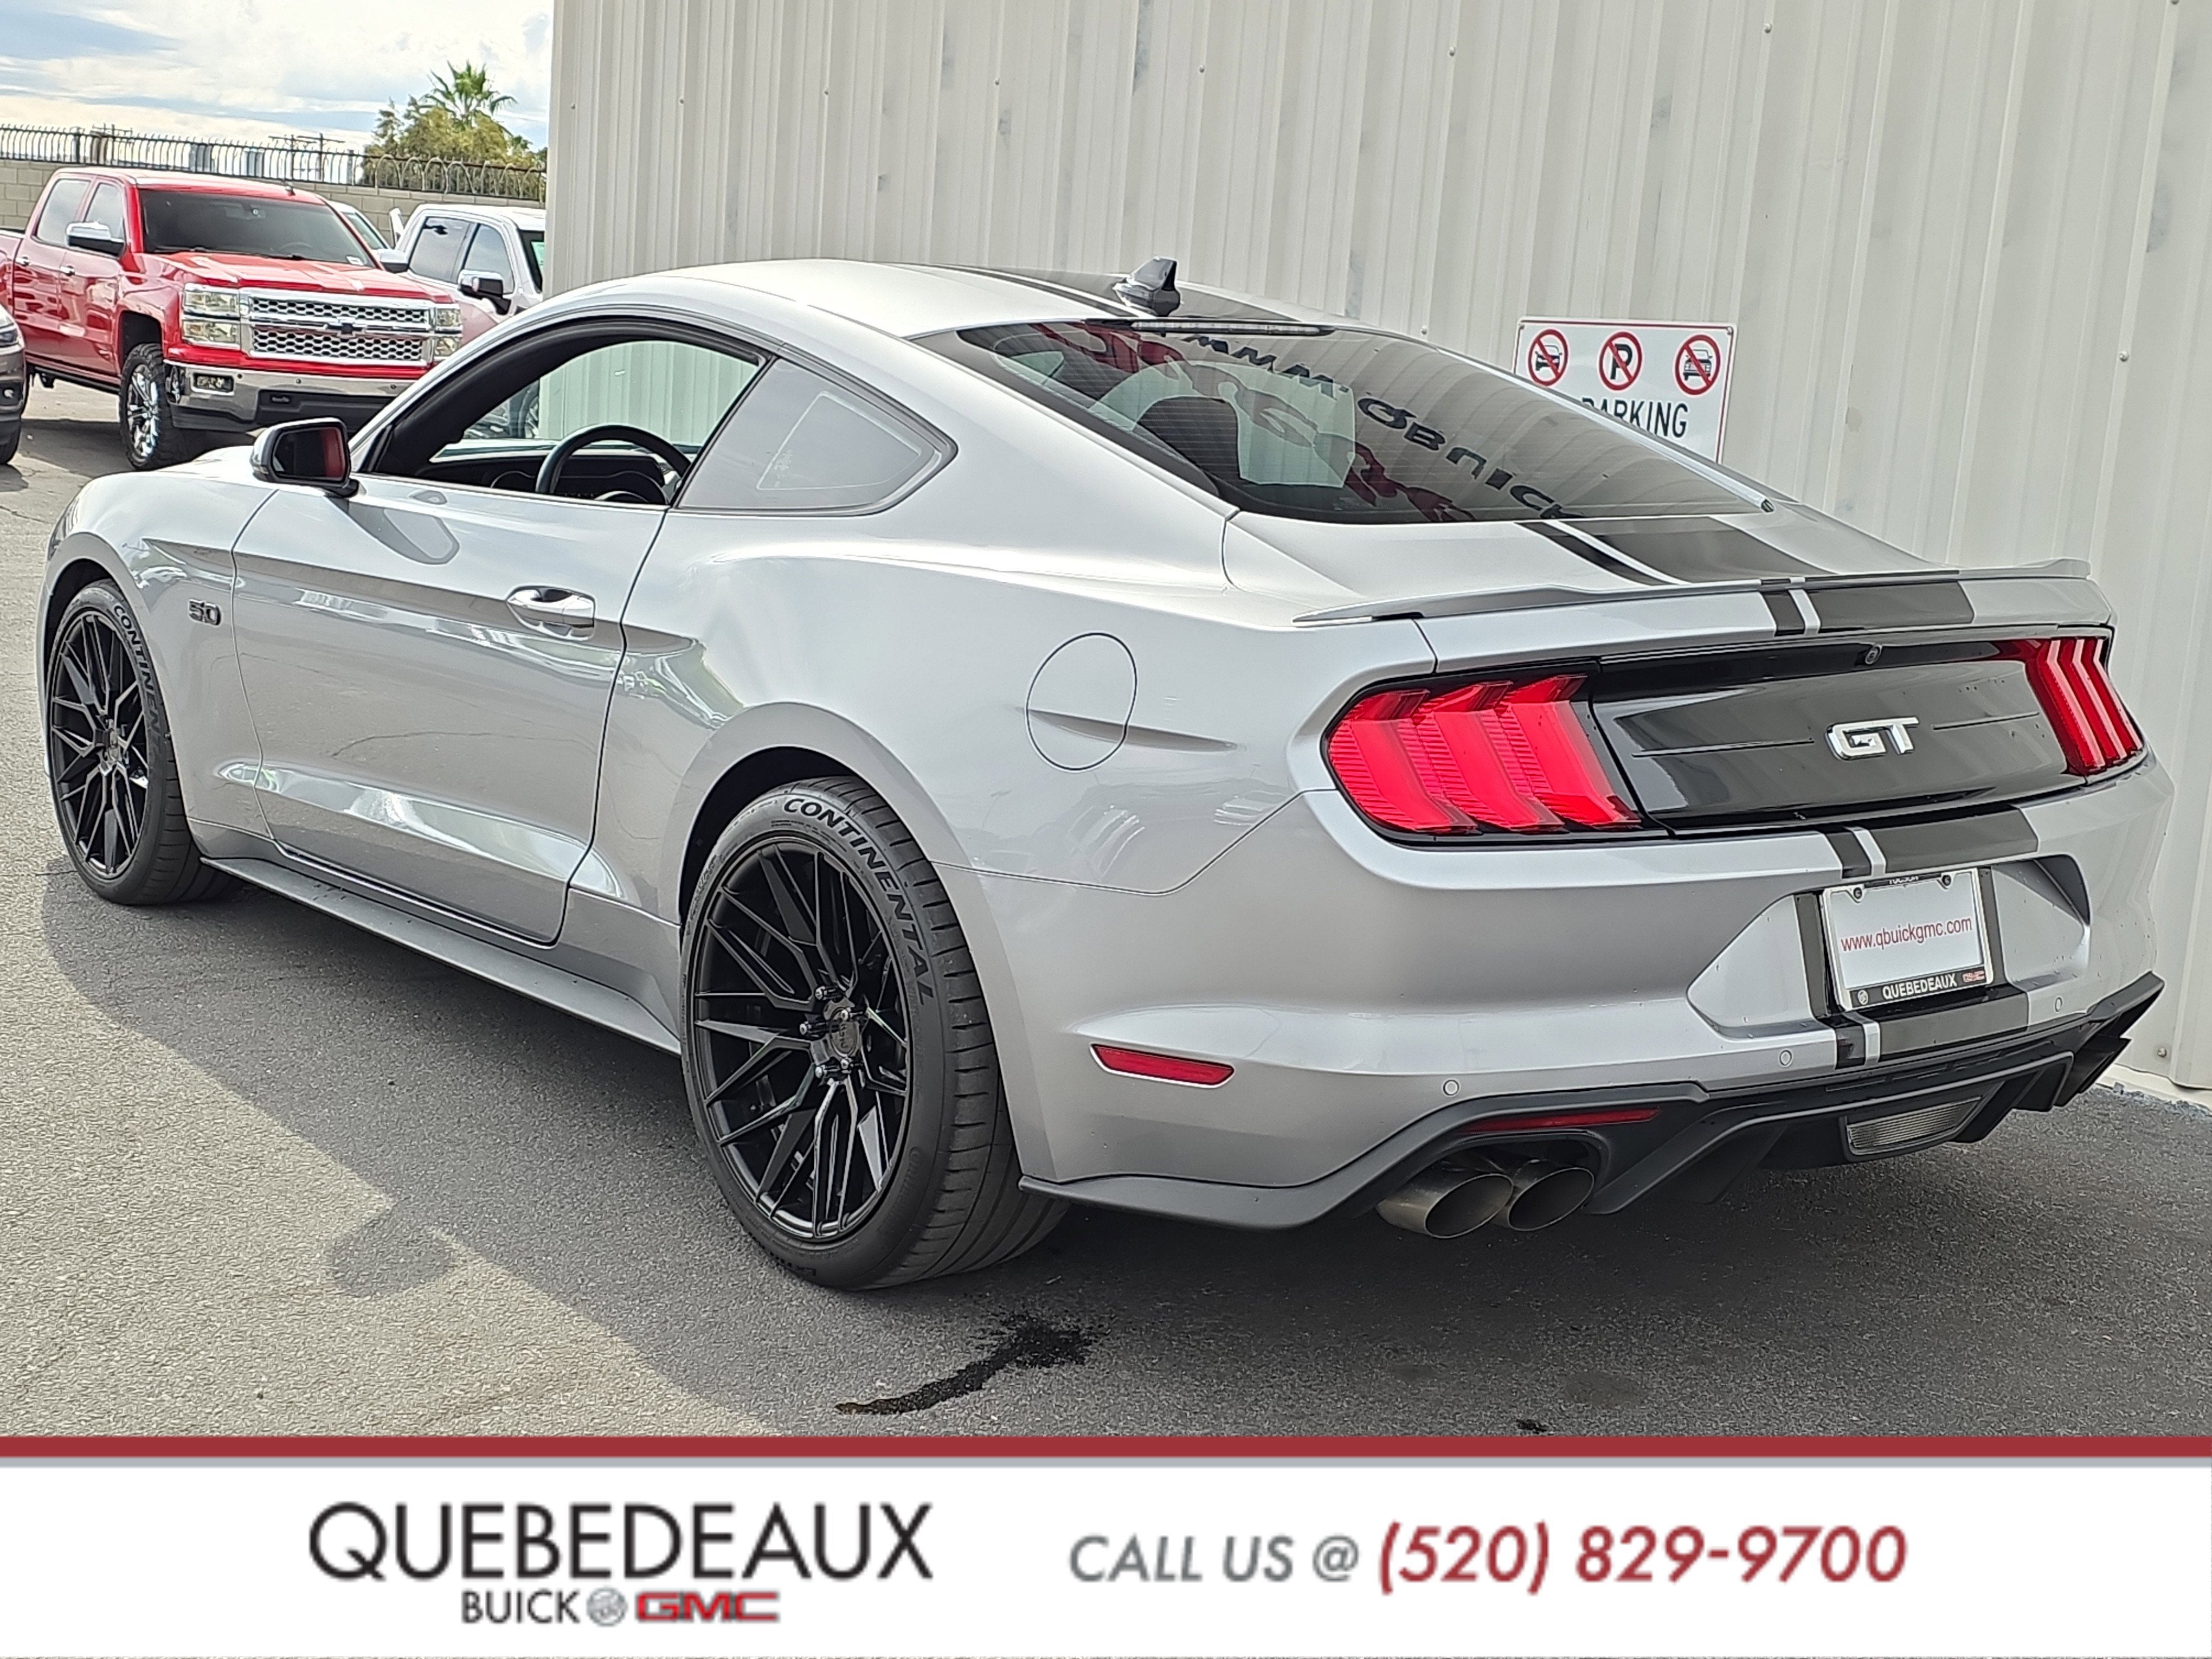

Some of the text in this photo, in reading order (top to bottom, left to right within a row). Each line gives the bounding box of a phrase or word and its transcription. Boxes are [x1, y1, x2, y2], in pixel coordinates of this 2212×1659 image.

[1582, 397, 1688, 438] RKING
[1824, 716, 1920, 761] GT
[784, 798, 934, 1006] CONTINENTAL
[1841, 917, 1972, 951] www.qbuickgmc.com
[1882, 973, 1958, 1000] QUEBEDEAUX
